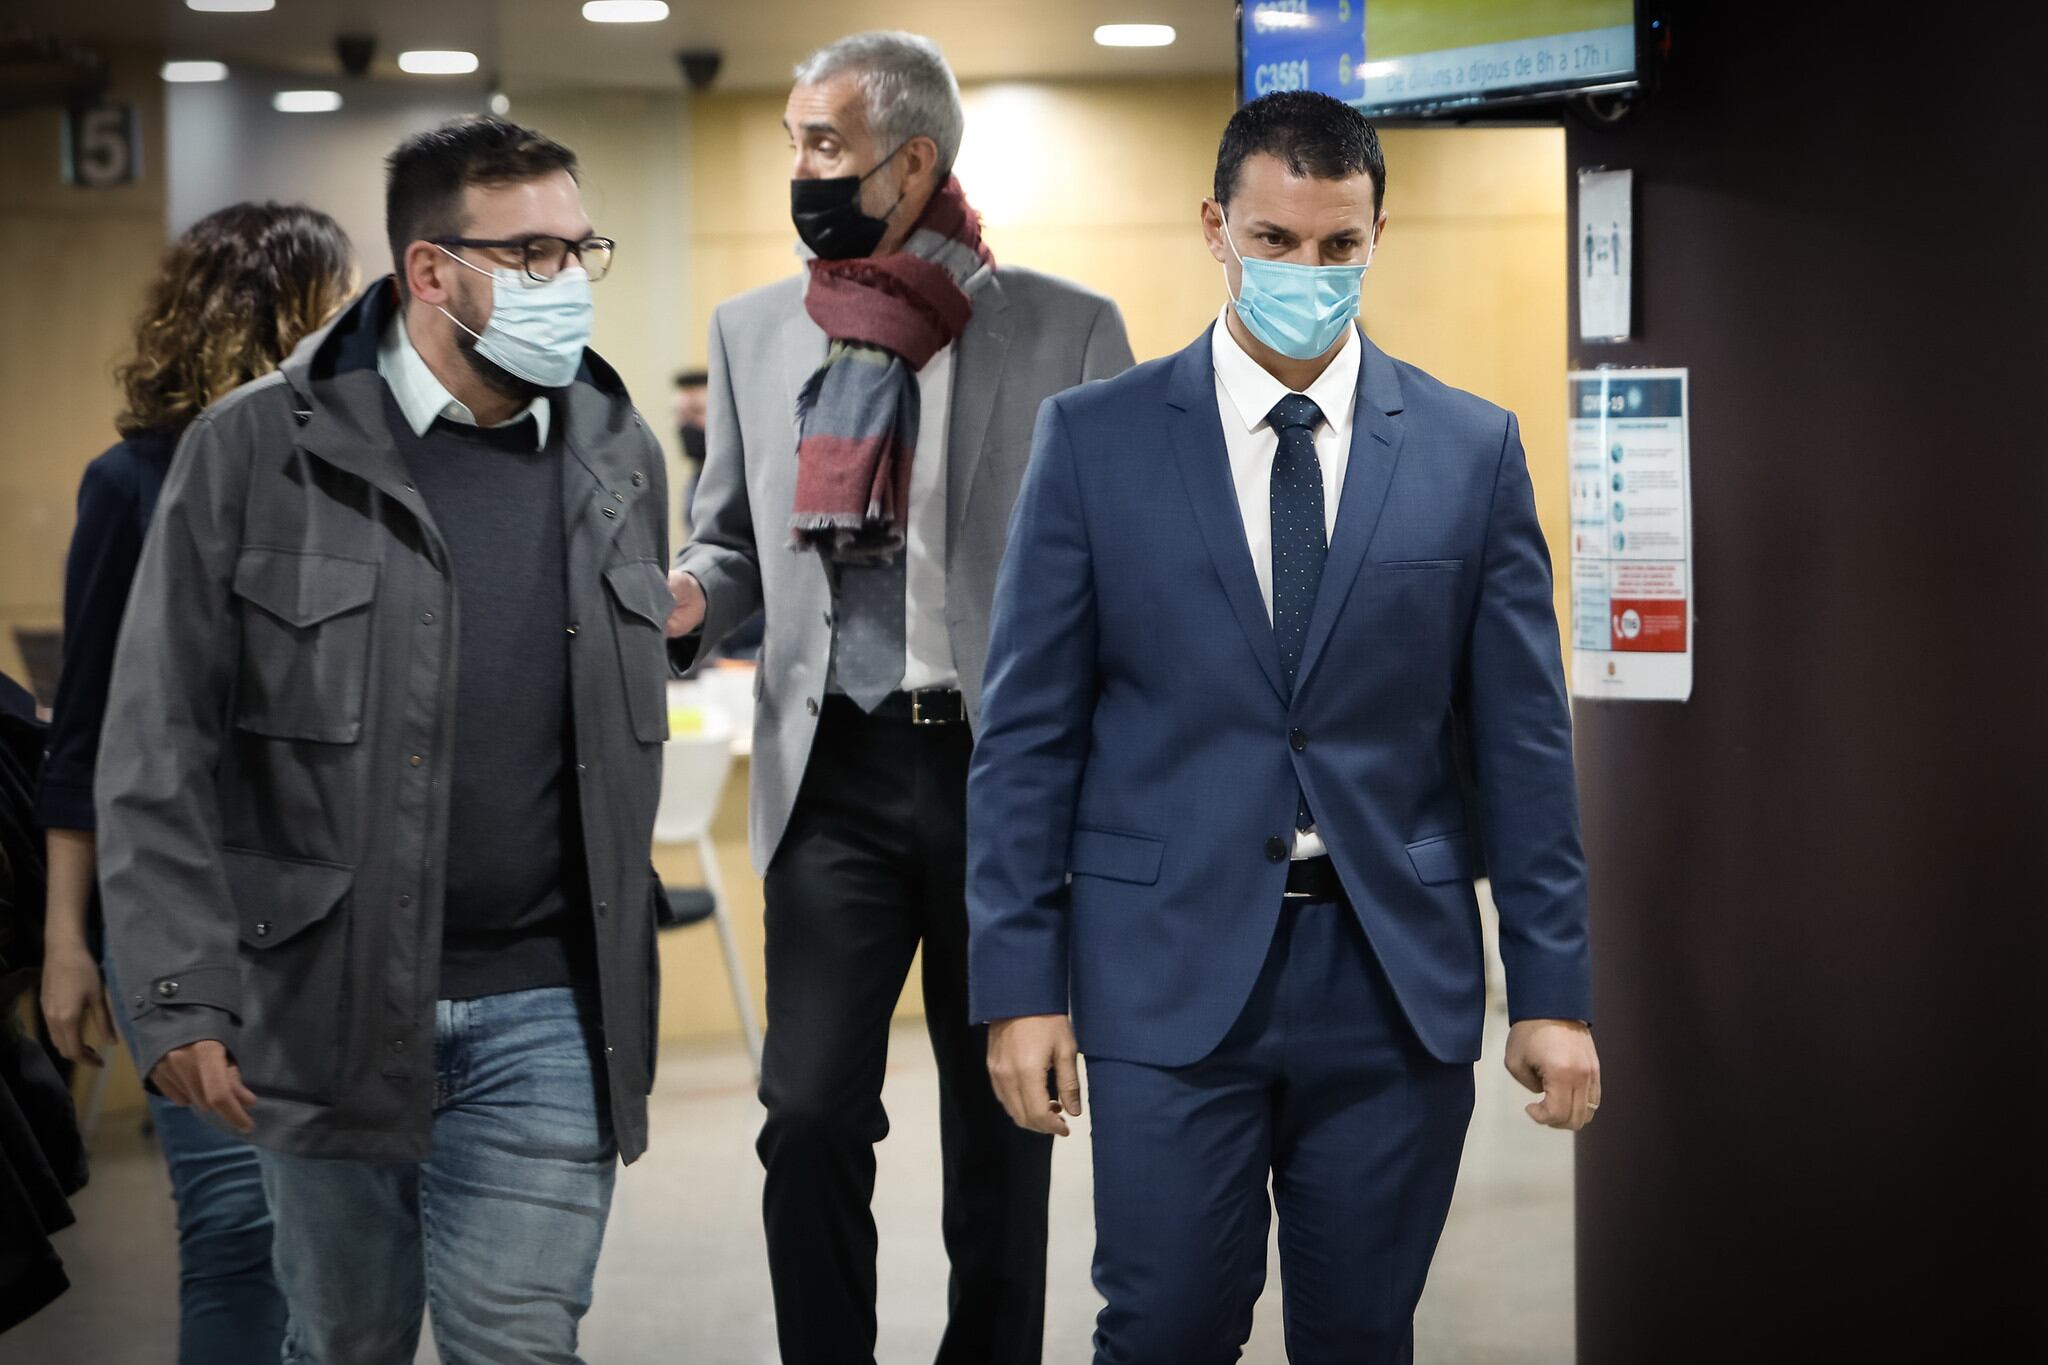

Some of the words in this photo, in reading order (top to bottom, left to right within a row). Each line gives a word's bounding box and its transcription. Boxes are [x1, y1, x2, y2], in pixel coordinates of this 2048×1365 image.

[1339, 53, 1351, 86] 6
[1468, 60, 1511, 88] dijous
[1514, 54, 1532, 77] de
[1536, 49, 1555, 74] 8h
[1559, 53, 1568, 71] a
[1573, 45, 1600, 69] 17h
[81, 110, 128, 182] 5
[1582, 394, 1625, 412] COV-19
